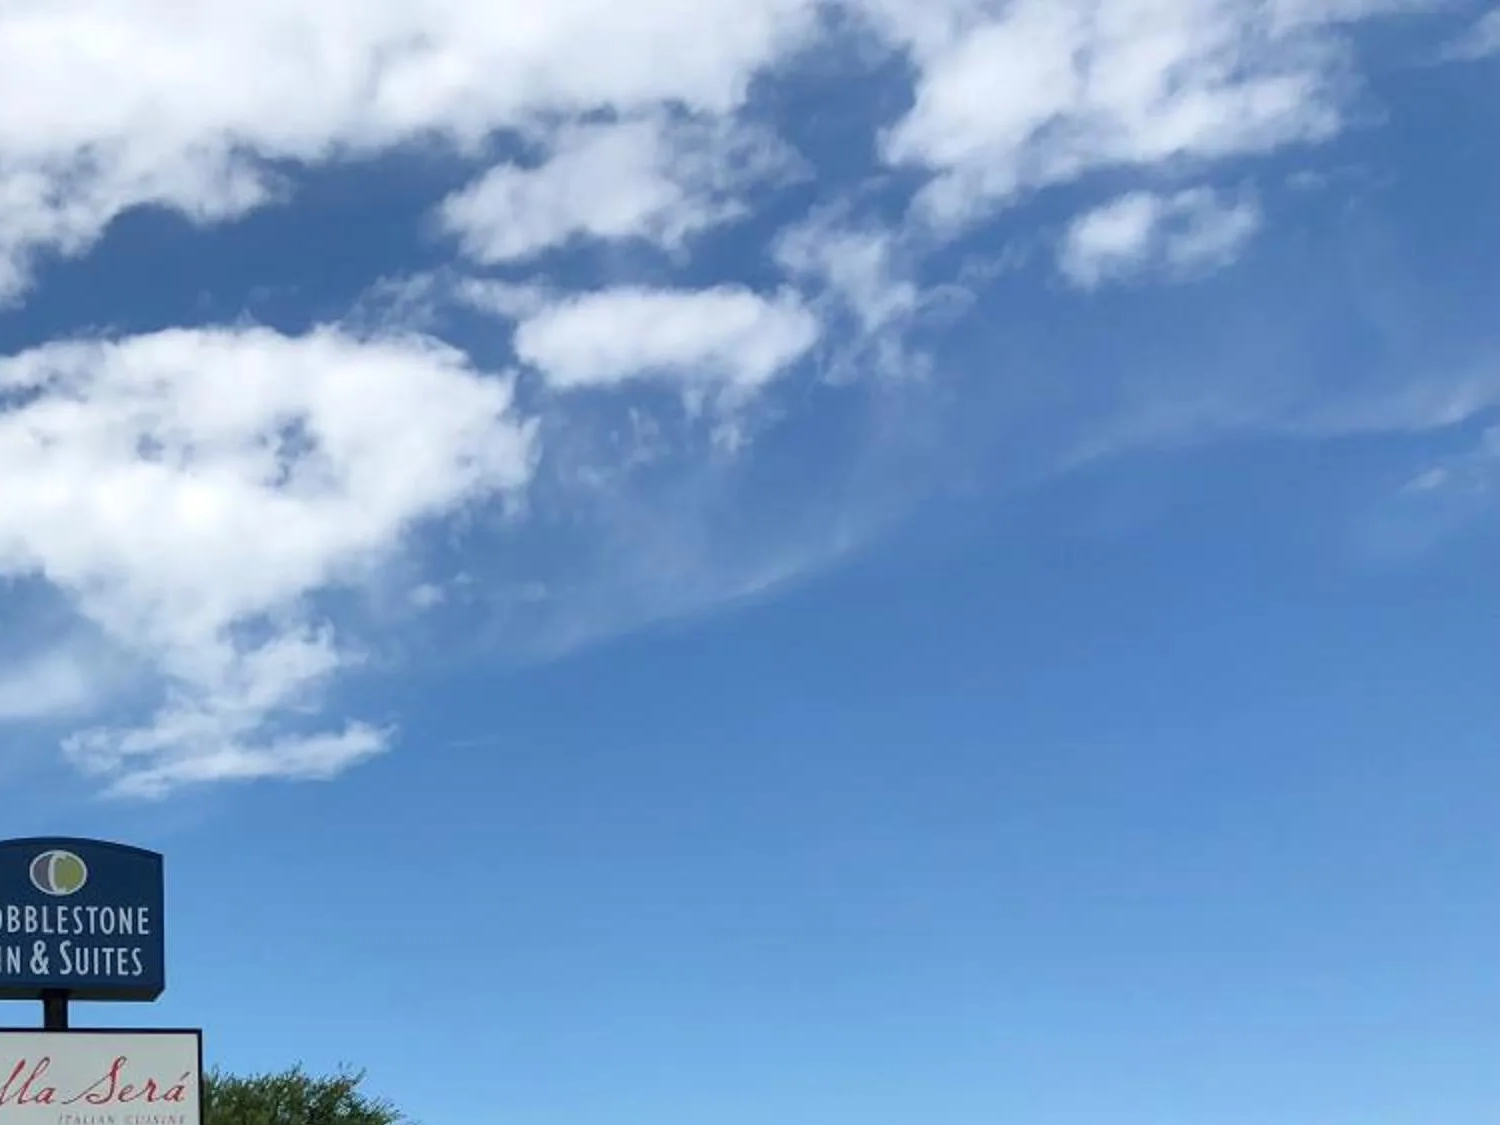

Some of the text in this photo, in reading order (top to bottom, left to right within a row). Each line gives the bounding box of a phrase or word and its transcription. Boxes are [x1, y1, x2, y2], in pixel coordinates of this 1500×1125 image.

[30, 940, 50, 975] &
[59, 940, 143, 976] SUITES
[57, 1114, 116, 1125] ITALIAN
